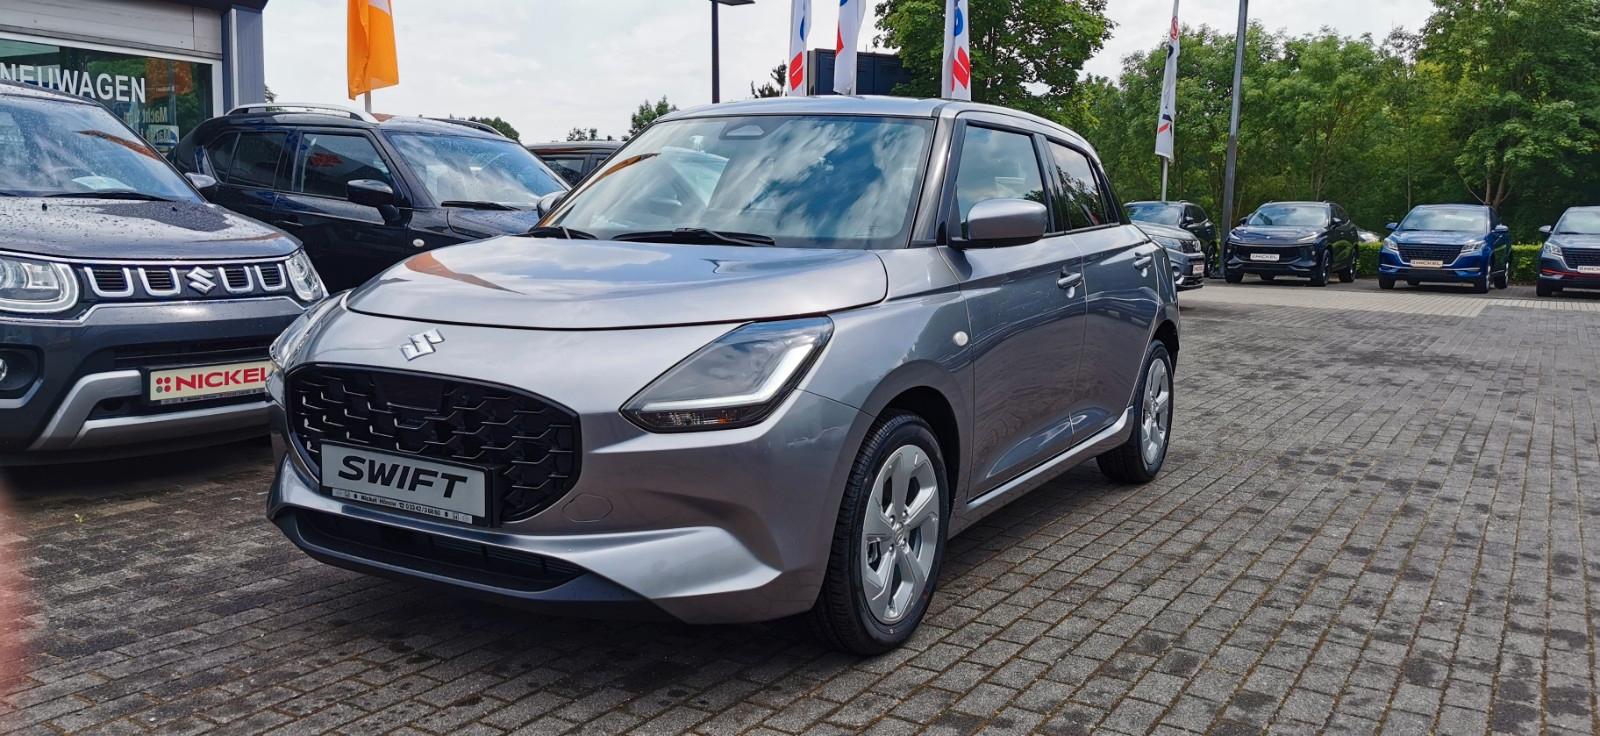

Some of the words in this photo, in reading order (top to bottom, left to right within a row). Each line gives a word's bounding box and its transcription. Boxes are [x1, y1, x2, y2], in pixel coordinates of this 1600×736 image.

[0, 62, 146, 103] NEUWAGEN
[175, 367, 266, 391] NICKEL
[338, 455, 468, 499] SWIFT
